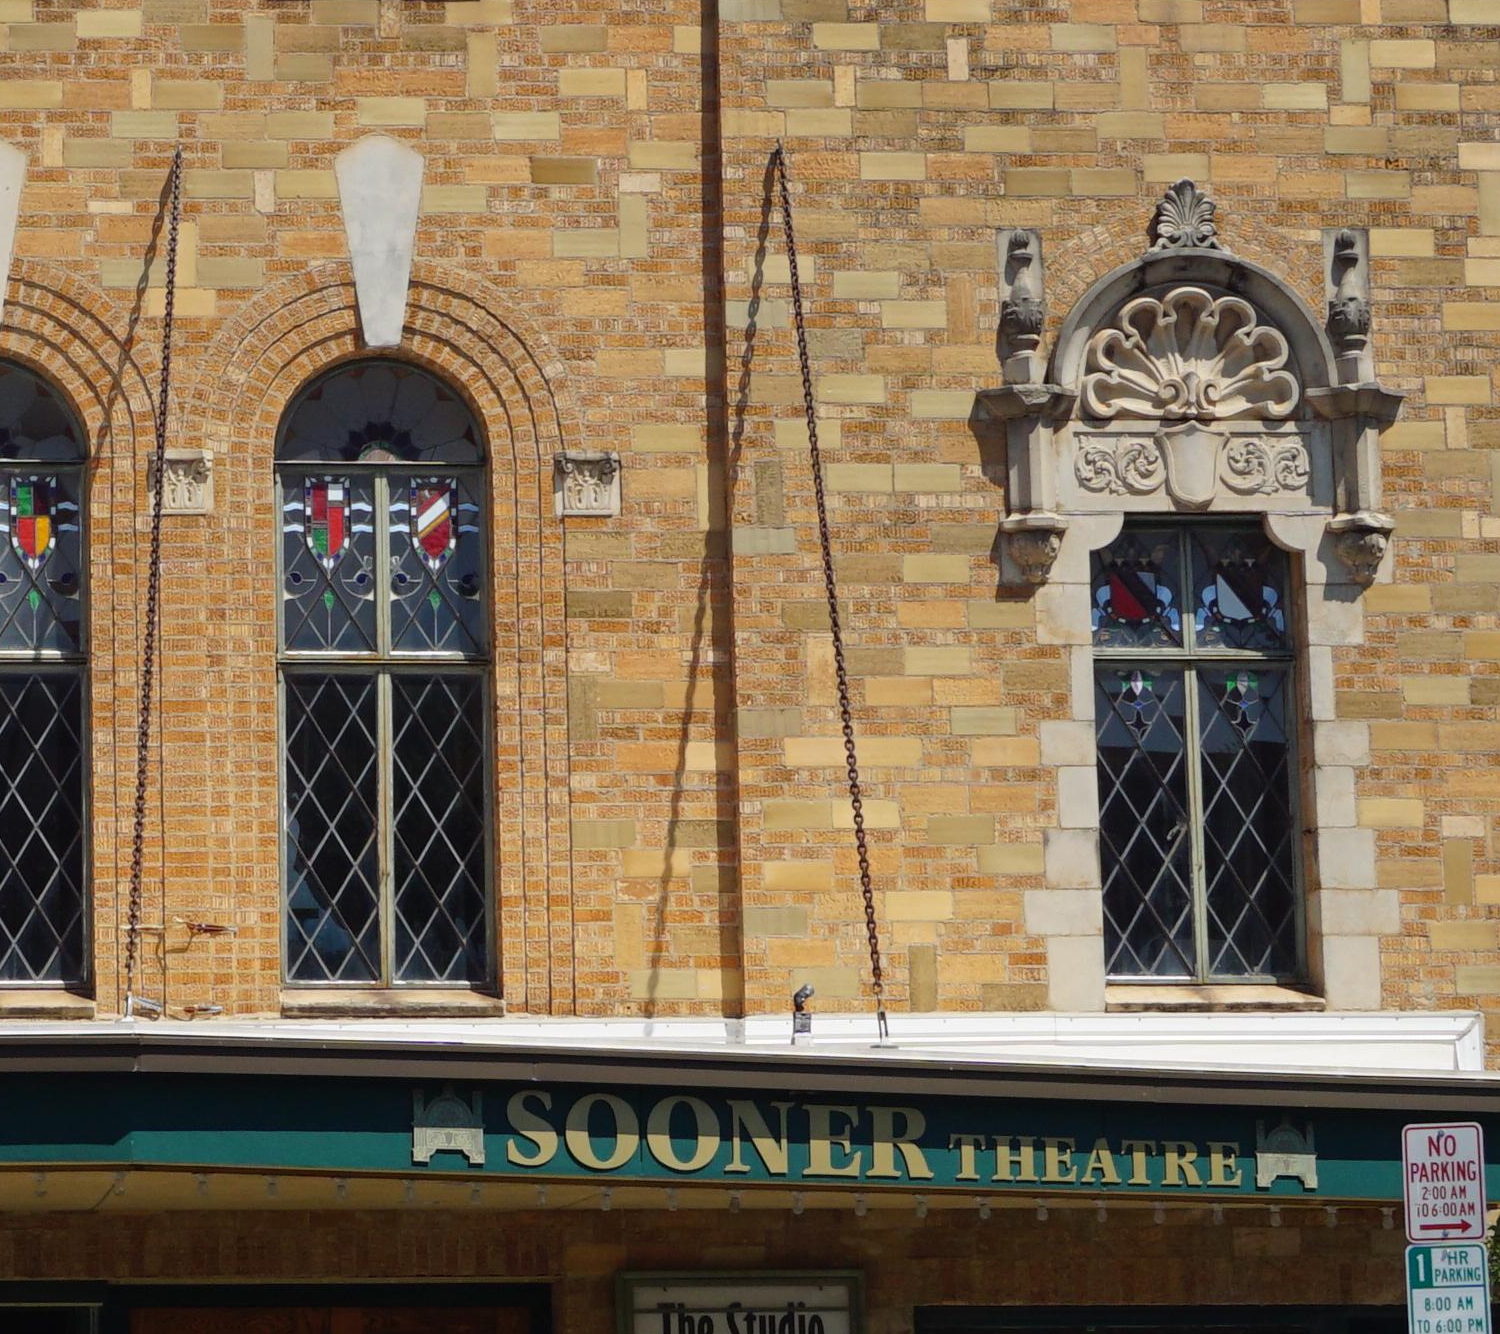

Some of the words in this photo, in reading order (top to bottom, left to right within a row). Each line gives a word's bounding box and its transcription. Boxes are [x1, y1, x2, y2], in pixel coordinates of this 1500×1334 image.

[506, 1089, 935, 1180] SOONER
[949, 1132, 1244, 1190] THEATRE
[1428, 1135, 1457, 1157] NO
[1410, 1161, 1477, 1183] PARKING
[1422, 1186, 1447, 1200] 2:00
[1451, 1185, 1467, 1199] AM
[1431, 1203, 1458, 1217] 6:00
[1458, 1201, 1476, 1216] AM
[1416, 1254, 1426, 1283] 1
[1448, 1251, 1469, 1265] HR
[1434, 1267, 1481, 1283] PARKING
[1424, 1297, 1452, 1312] 8:00
[1457, 1296, 1473, 1311] AM
[1417, 1319, 1430, 1334] TO
[1435, 1318, 1462, 1333] 6:00
[1468, 1317, 1484, 1333] PM
